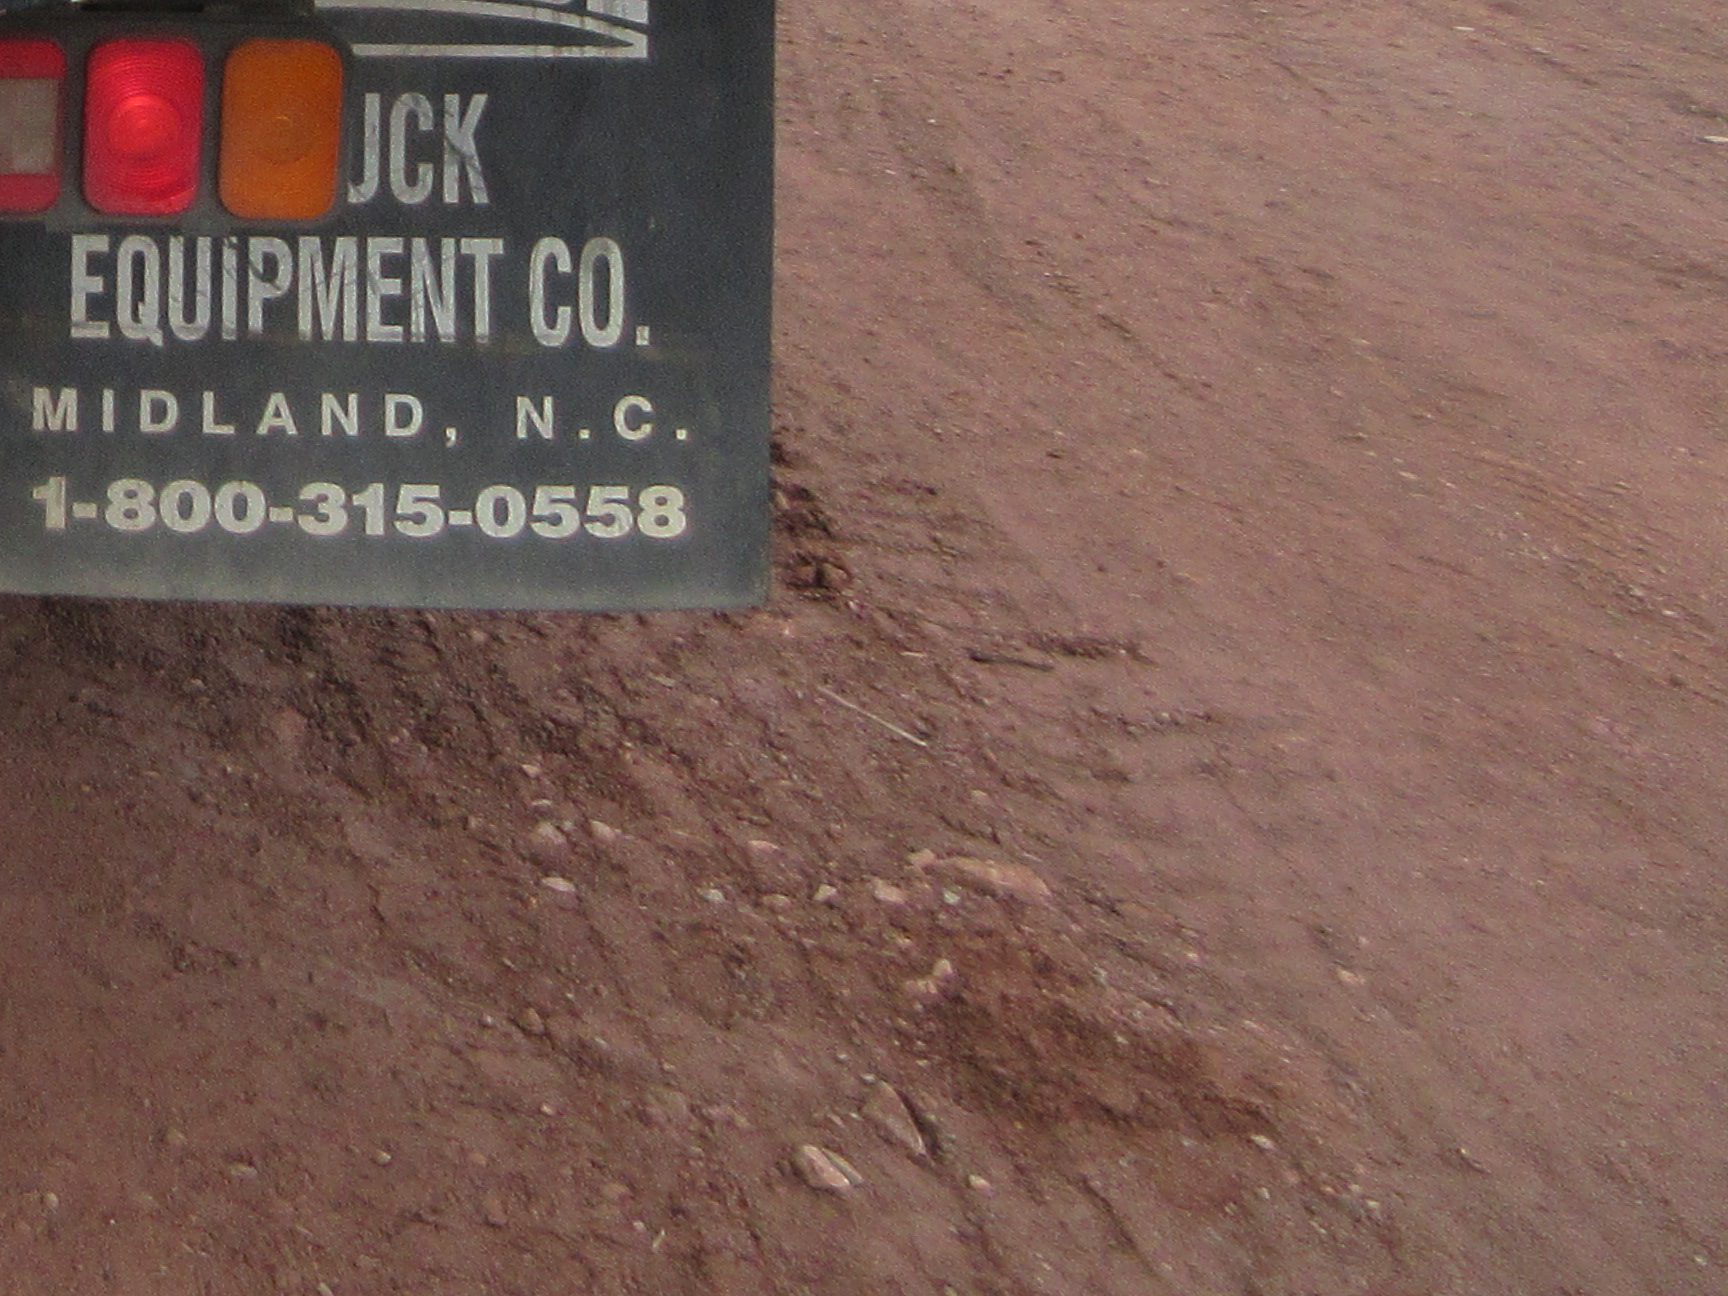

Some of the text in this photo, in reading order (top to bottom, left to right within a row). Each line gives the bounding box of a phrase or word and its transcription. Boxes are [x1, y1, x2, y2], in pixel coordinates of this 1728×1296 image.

[69, 234, 650, 348] EQUIPMENT CO.
[31, 388, 689, 447] MIDLAND, N.C.
[31, 477, 688, 539] 1-800-315-0558
